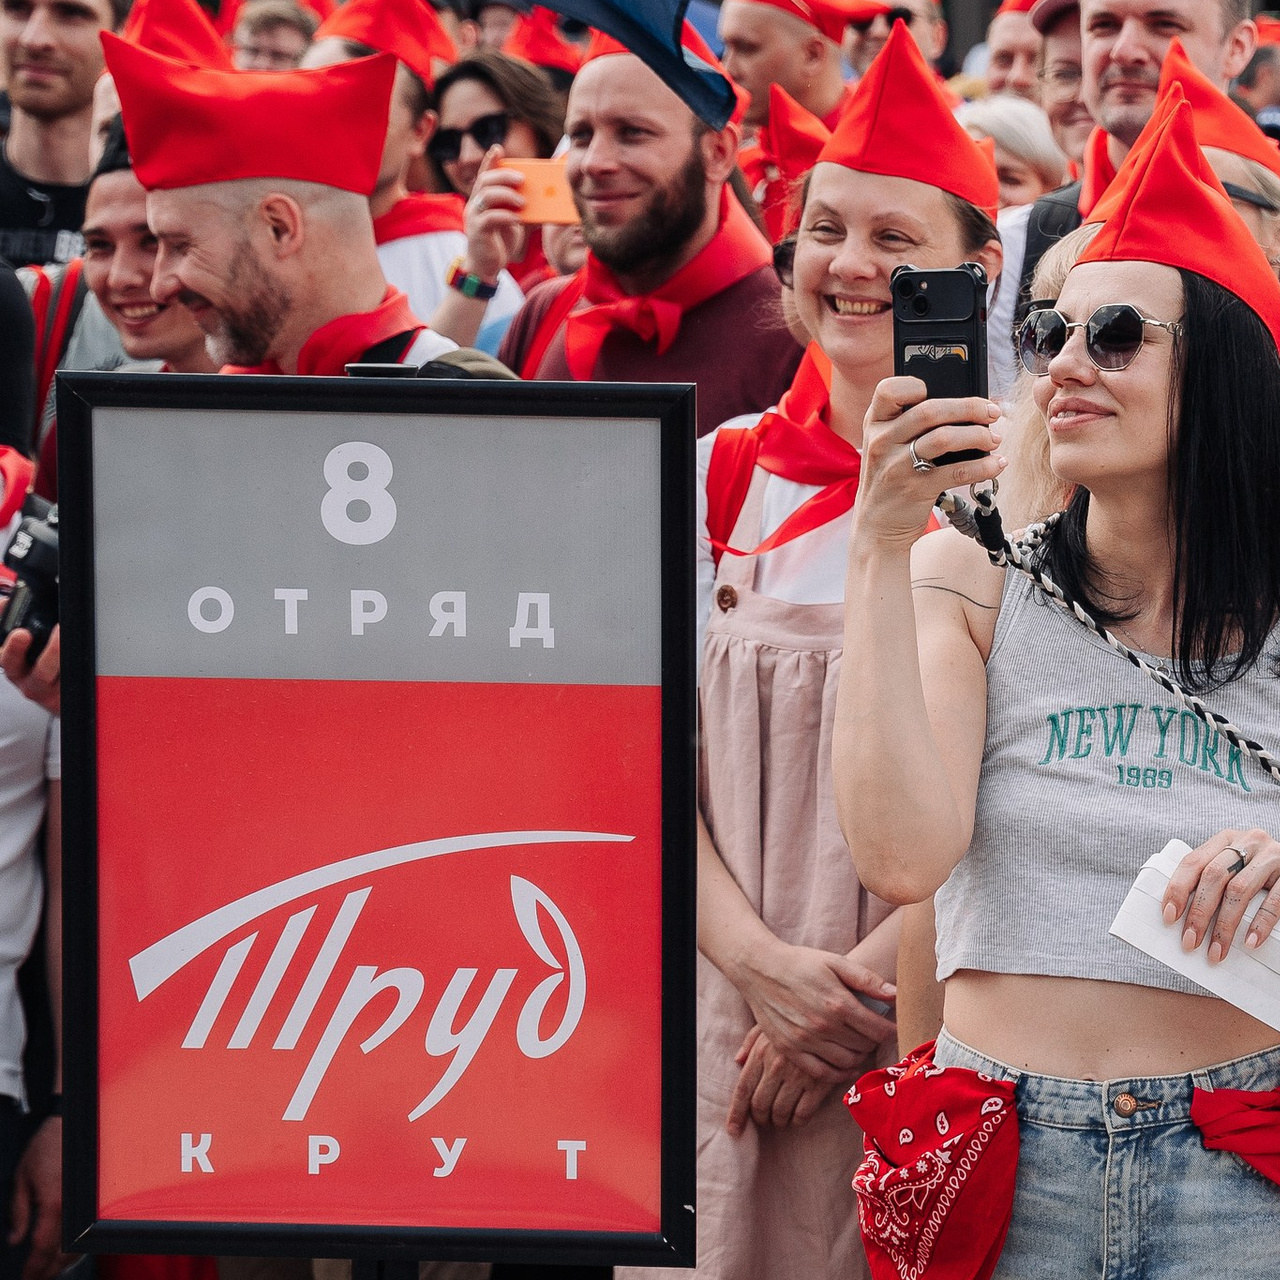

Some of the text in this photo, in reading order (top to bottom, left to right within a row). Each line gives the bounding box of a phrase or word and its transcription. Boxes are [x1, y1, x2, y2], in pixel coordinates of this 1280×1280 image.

[320, 441, 398, 546] 8
[187, 586, 555, 649] ОТРЯД
[1038, 703, 1144, 766] NEW
[1116, 763, 1174, 790] 1989
[128, 830, 637, 1123] Труд
[181, 1133, 587, 1180] КРУТ
